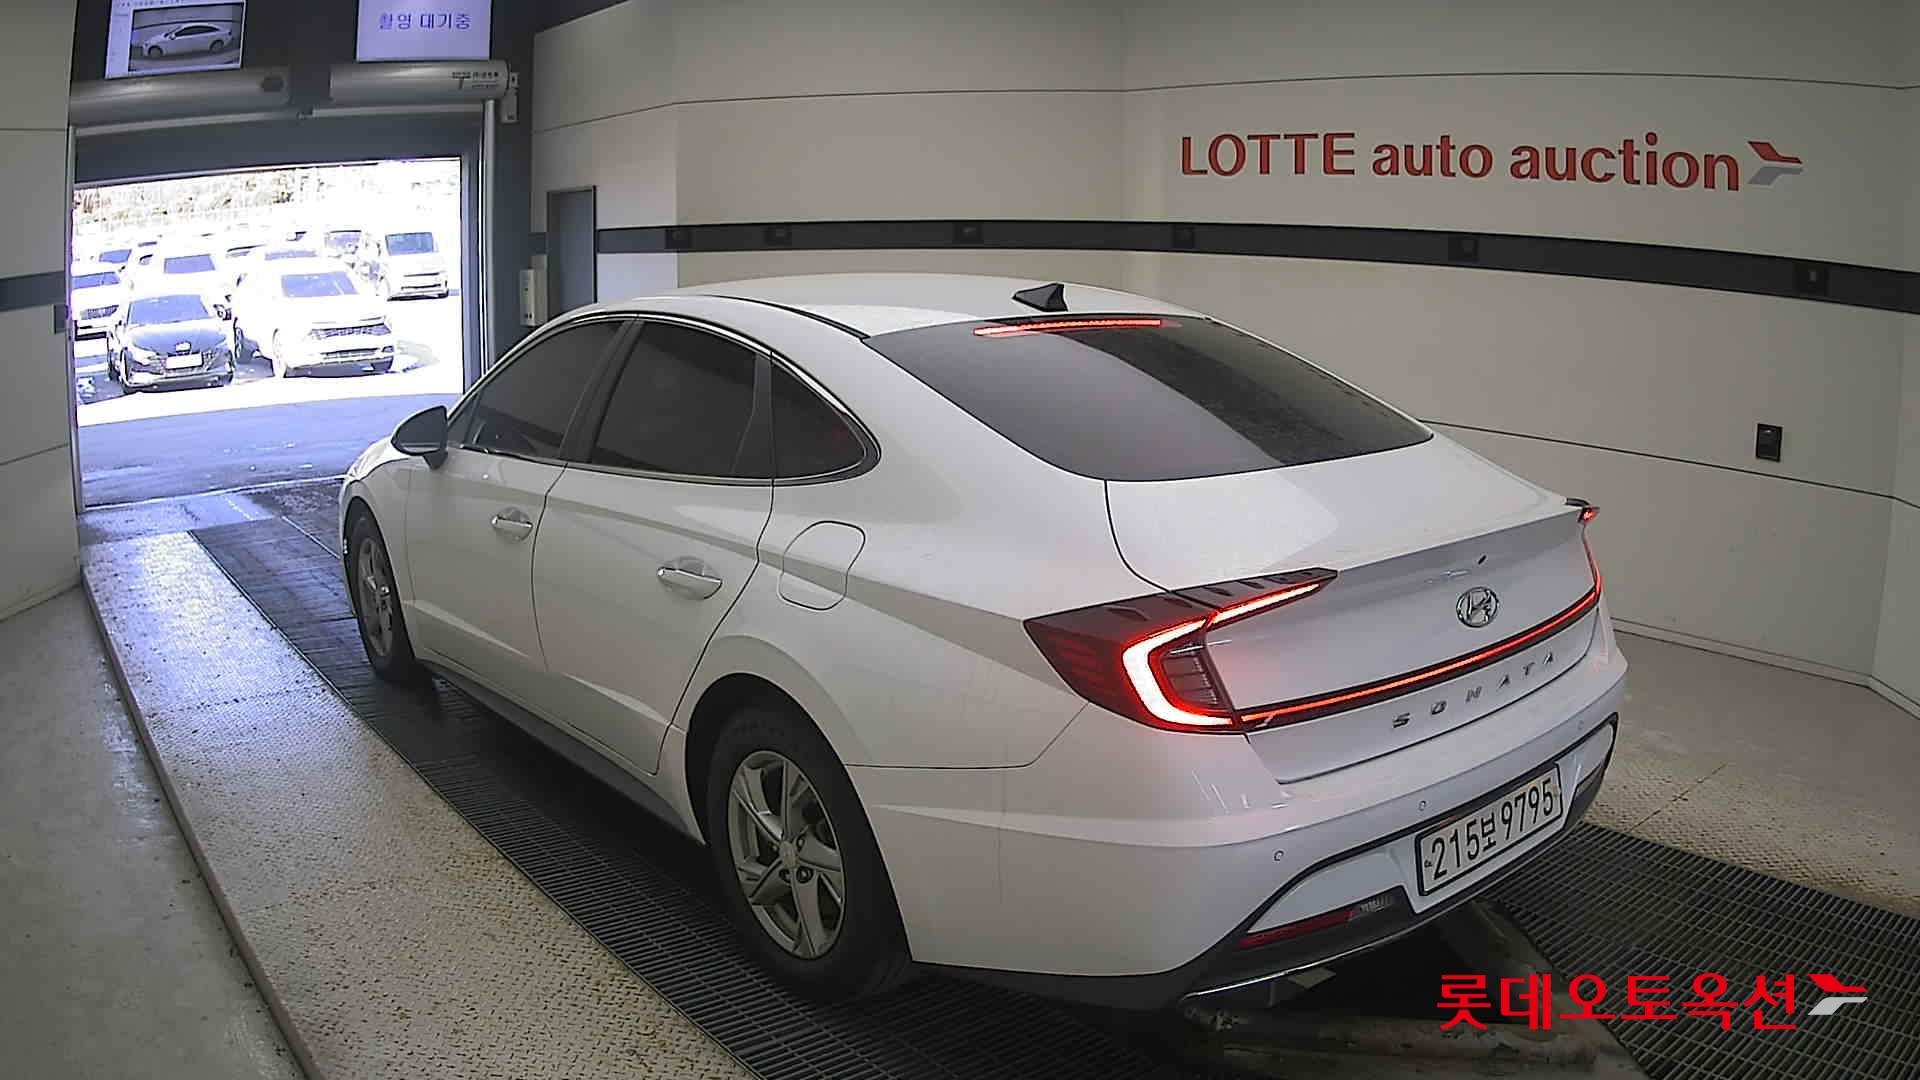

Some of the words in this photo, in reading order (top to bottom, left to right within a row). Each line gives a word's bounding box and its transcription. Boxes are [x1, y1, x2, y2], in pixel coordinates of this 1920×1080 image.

[420, 13, 471, 30] 대기중
[1181, 132, 1355, 177] LOTTE
[1371, 134, 1494, 178] auto
[1510, 131, 1740, 191] auction
[1392, 651, 1554, 729] SONATA
